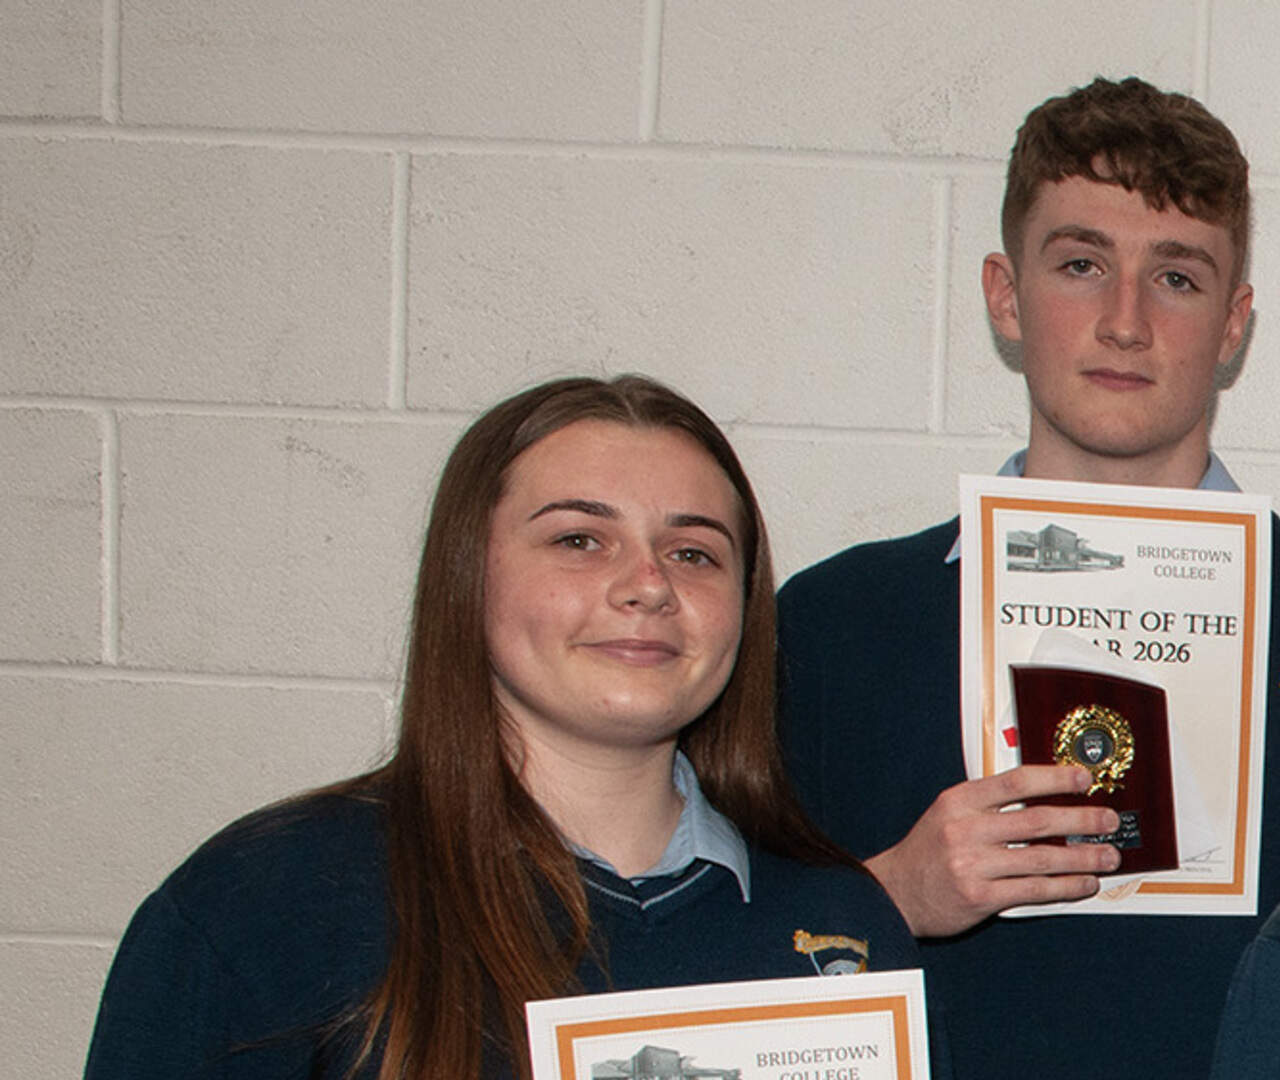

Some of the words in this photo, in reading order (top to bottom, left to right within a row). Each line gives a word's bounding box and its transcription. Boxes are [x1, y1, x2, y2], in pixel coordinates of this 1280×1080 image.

[1136, 545, 1233, 564] BRIDGETOWN
[1153, 564, 1217, 581] COLLEGE
[1000, 602, 1132, 631] STUDENT
[1139, 610, 1177, 632] OF
[1183, 613, 1238, 636] THE
[1133, 640, 1192, 663] 2026
[756, 1044, 881, 1068] BRIDGETOWN
